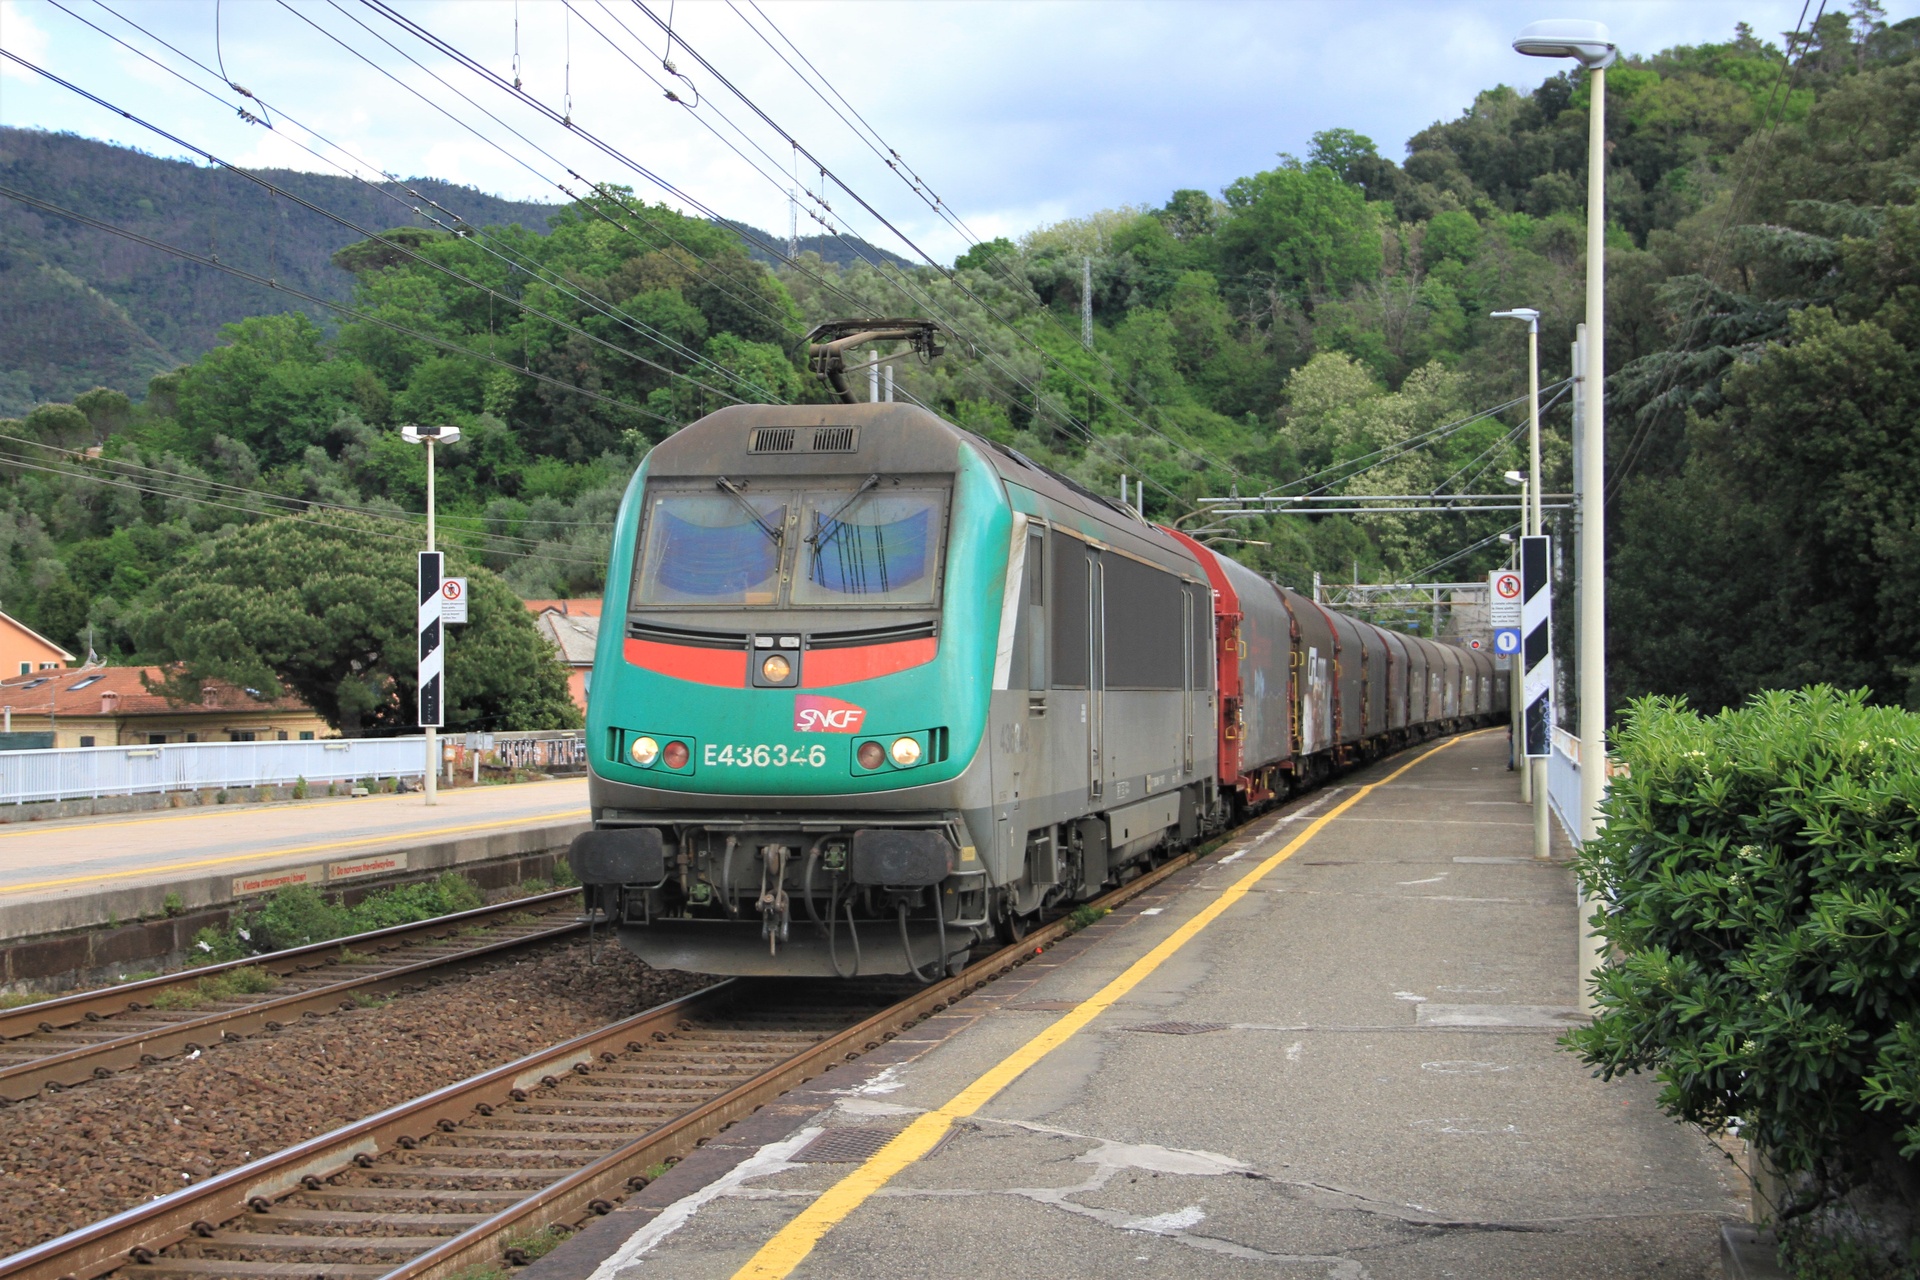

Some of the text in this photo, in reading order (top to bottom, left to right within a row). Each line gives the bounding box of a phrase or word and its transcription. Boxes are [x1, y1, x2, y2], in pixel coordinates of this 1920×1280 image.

[1504, 635, 1510, 648] 1
[797, 709, 862, 728] SNCF
[704, 744, 826, 767] E436346
